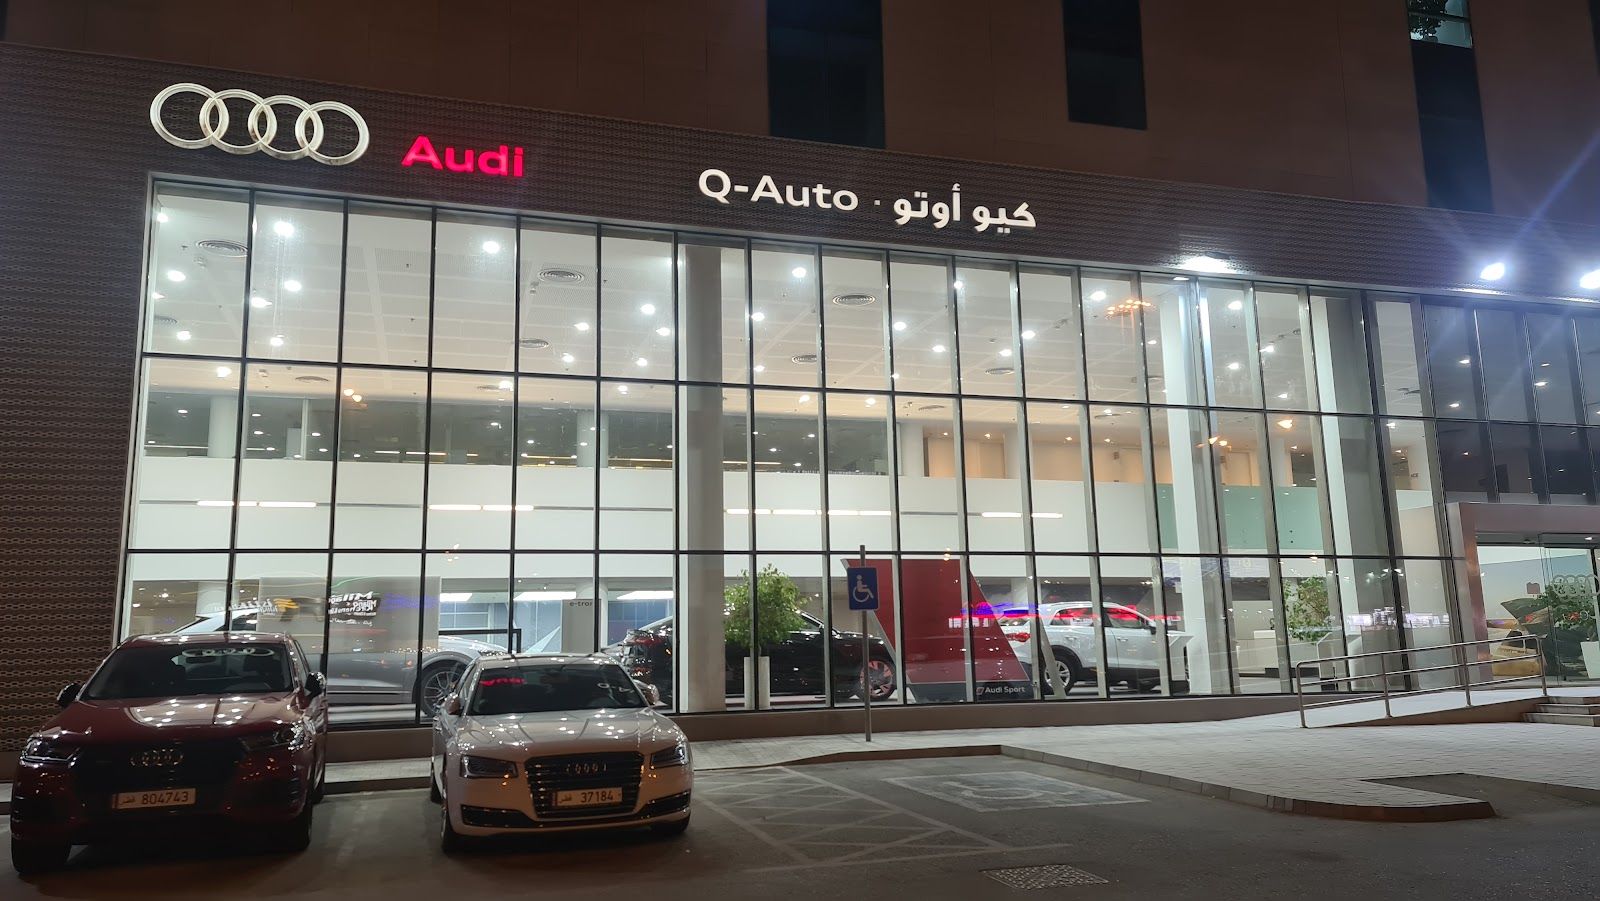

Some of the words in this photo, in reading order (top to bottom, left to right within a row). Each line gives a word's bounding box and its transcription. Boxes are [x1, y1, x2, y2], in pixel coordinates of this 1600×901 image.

[401, 135, 524, 178] Audi
[698, 168, 859, 211] Q-Auto
[893, 182, 961, 230] أوتو
[971, 201, 1037, 236] كيو
[985, 686, 1002, 694] Audi
[1004, 686, 1026, 694] Sport
[142, 791, 189, 805] 804743
[580, 790, 614, 803] 37184
